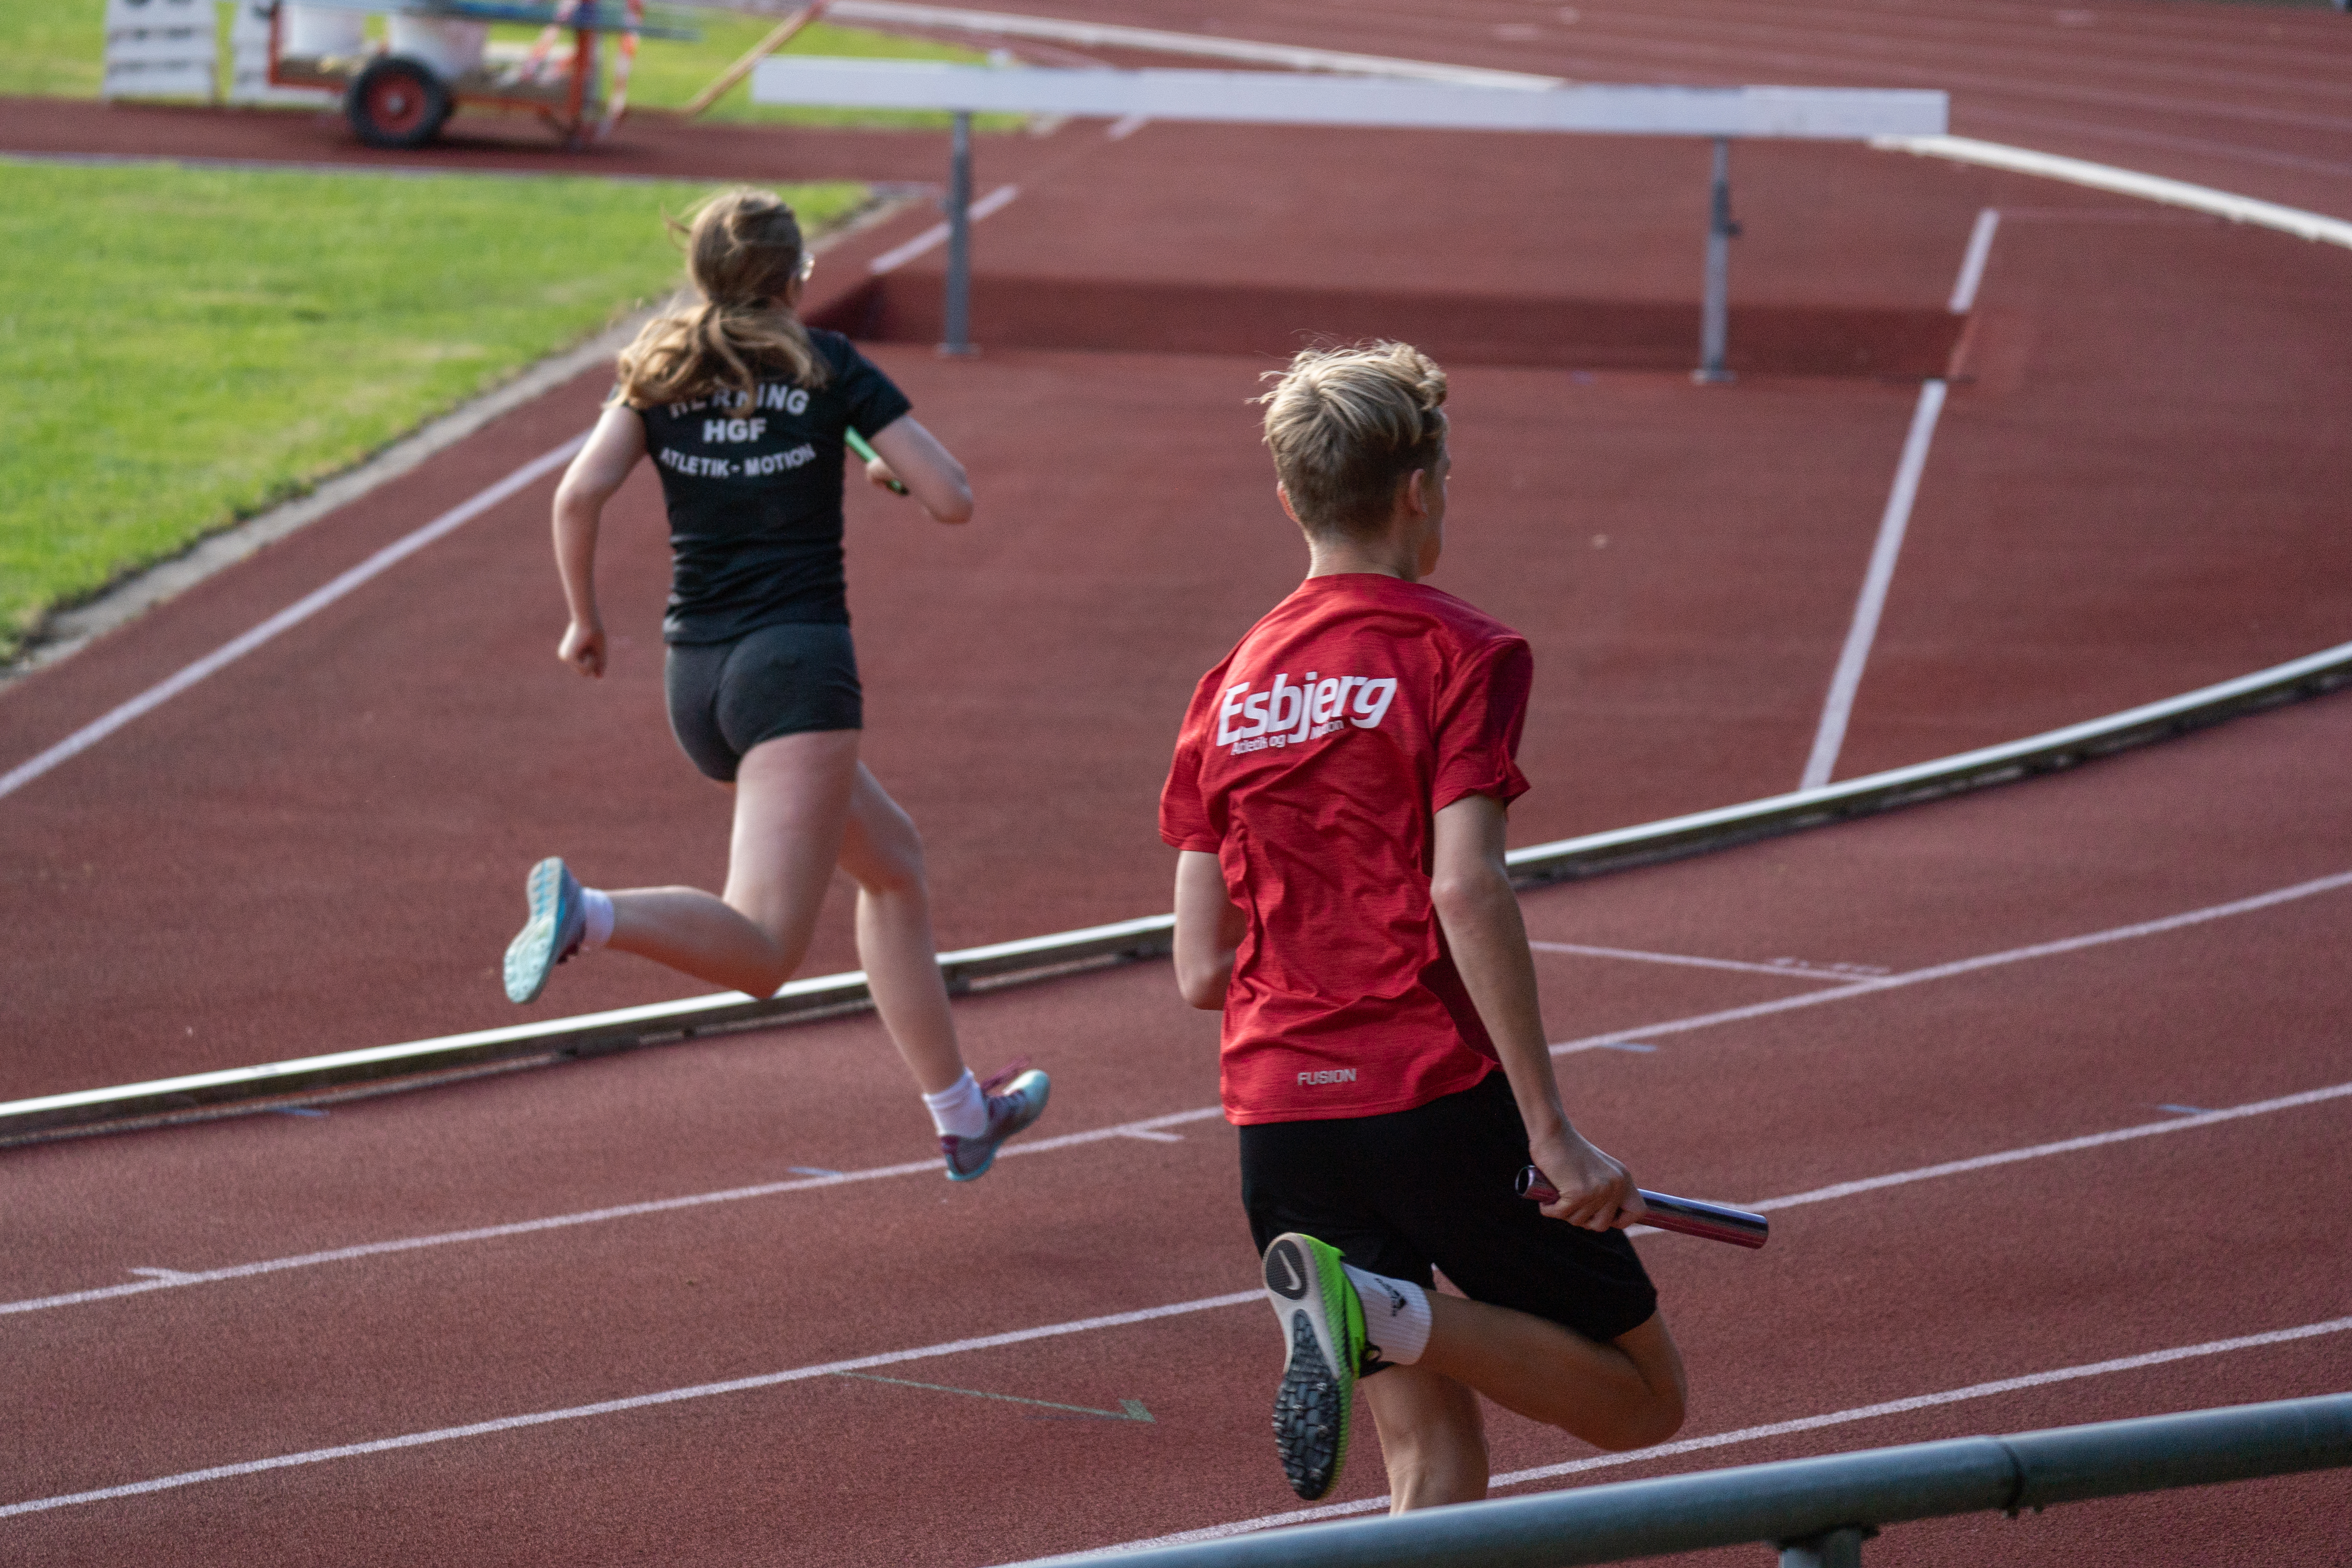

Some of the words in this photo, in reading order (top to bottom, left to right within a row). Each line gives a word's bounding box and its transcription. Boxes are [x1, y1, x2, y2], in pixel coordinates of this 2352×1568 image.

[703, 418, 766, 443] HGF
[660, 448, 730, 478] ATLETIK
[745, 443, 816, 476] MOTION
[1216, 672, 1397, 747] Esbjerg
[1269, 734, 1287, 748] og
[1297, 1068, 1357, 1086] FUSION
